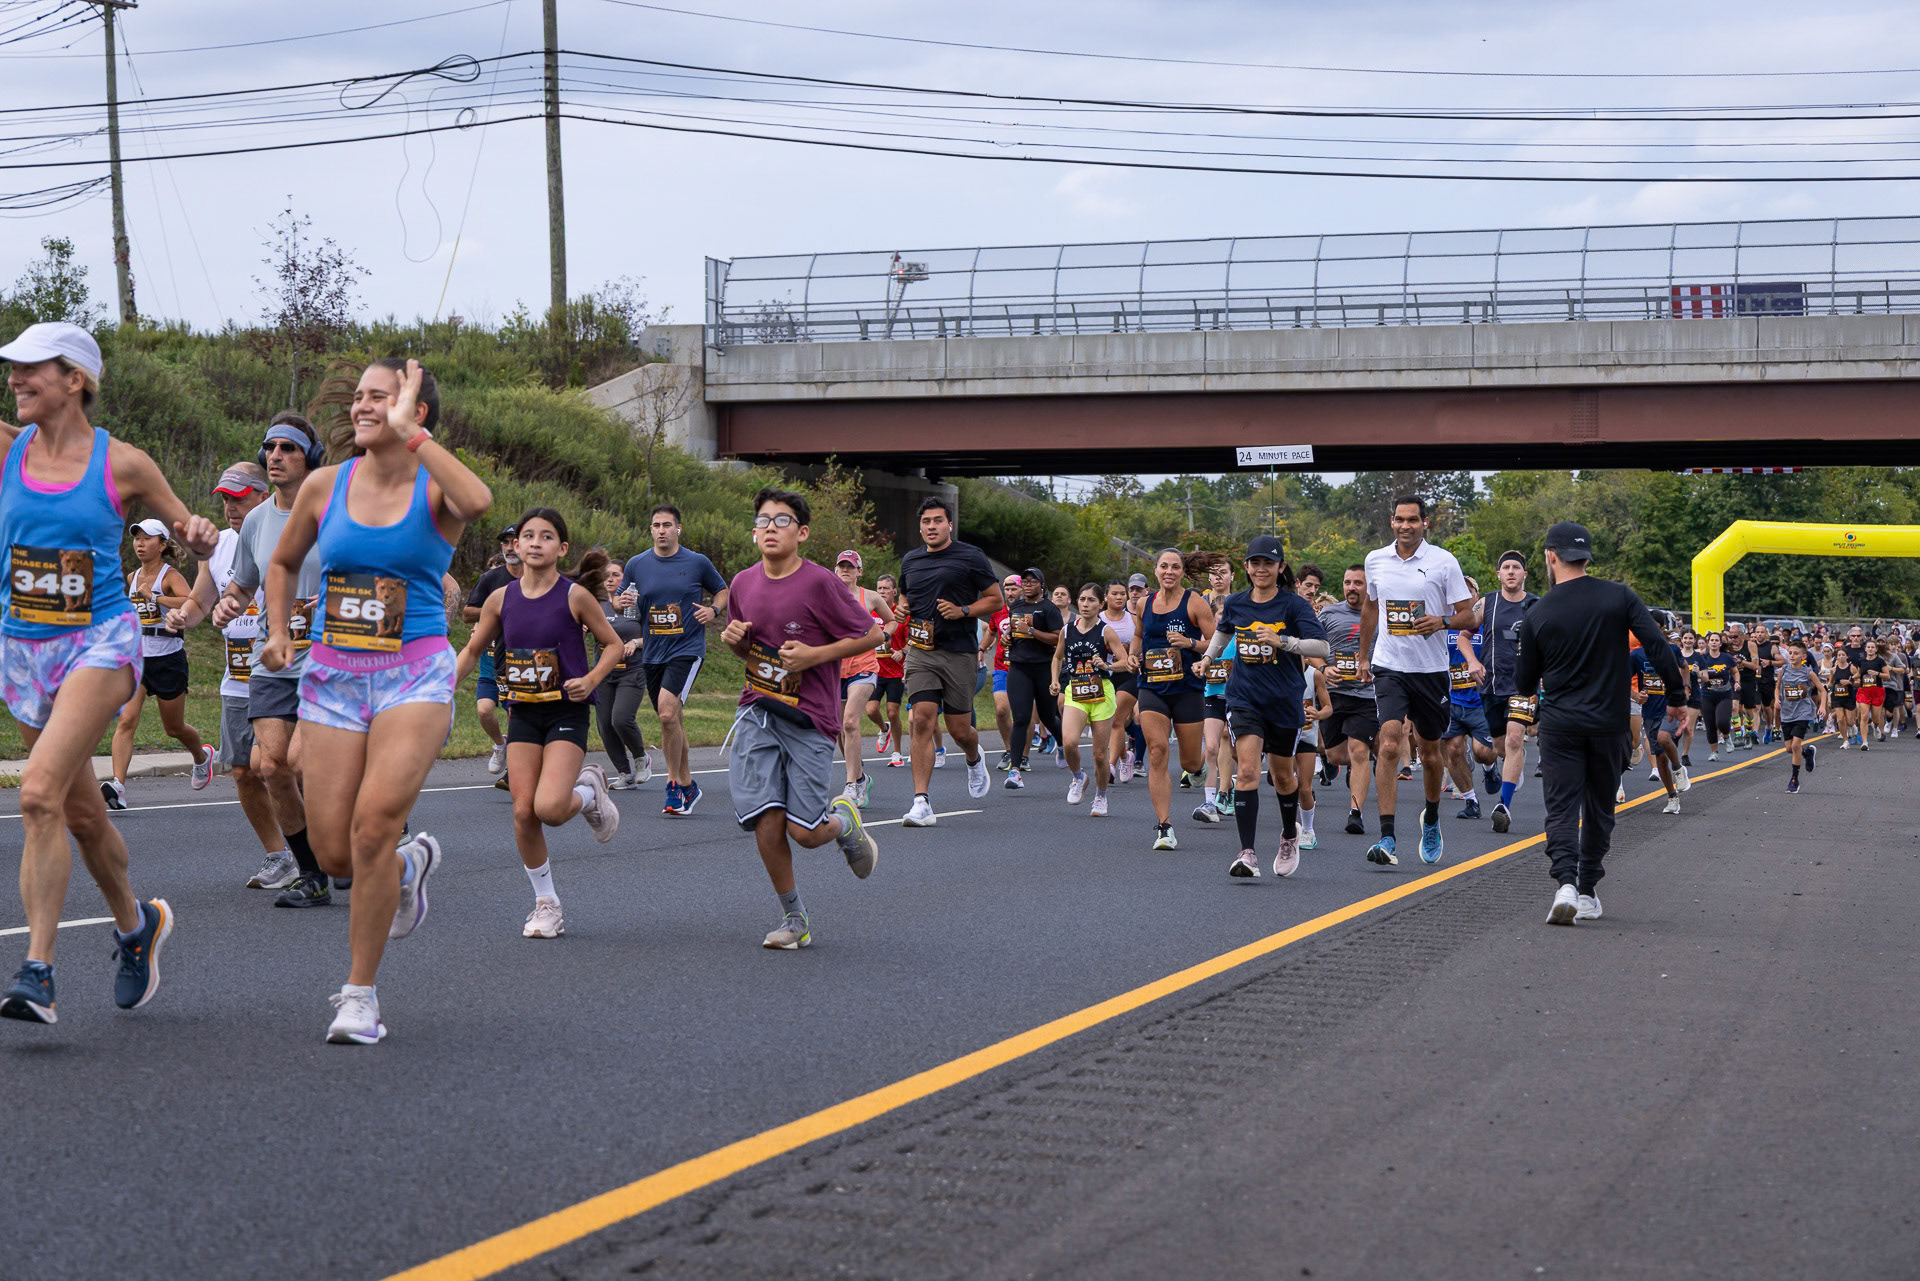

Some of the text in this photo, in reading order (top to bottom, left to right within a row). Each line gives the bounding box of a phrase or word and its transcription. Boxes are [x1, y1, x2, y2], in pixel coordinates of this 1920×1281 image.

[1239, 452, 1252, 462] 24
[1292, 451, 1310, 459] PACE
[12, 549, 28, 557] THE
[11, 558, 41, 568] CHASE
[14, 569, 86, 596] 348
[328, 586, 356, 594] CHASE
[339, 597, 386, 621] 56
[652, 613, 677, 623] 159
[910, 627, 929, 639] 172
[1239, 643, 1273, 656] 209
[749, 650, 770, 661] CHASE
[1152, 658, 1174, 669] 43
[508, 666, 552, 682] 247
[757, 662, 788, 682] 37
[1209, 669, 1228, 678] 76
[1450, 671, 1470, 680] 135
[1075, 685, 1099, 695] 169
[1510, 699, 1535, 712] 344
